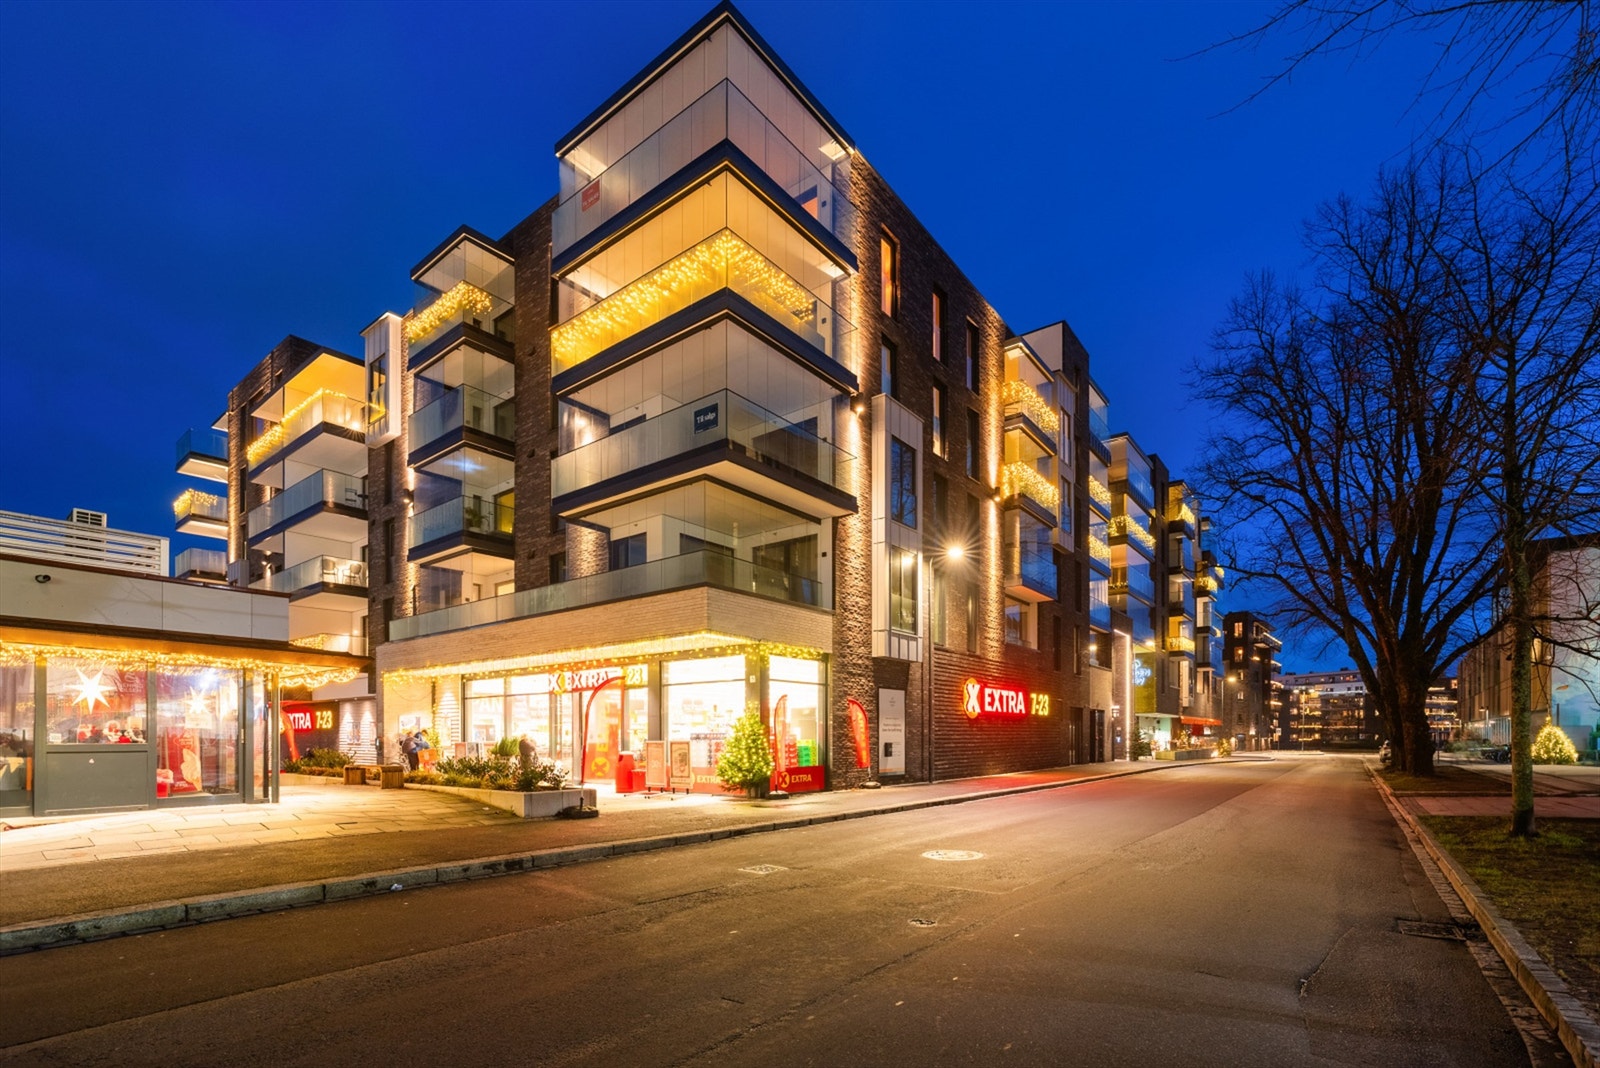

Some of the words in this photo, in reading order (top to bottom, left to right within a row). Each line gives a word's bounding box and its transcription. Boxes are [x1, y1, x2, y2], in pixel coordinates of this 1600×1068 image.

[565, 669, 609, 690] EXTRA
[984, 687, 1026, 714] EXTRA
[1030, 693, 1049, 716] 7-23
[287, 712, 312, 730] XTRA
[315, 710, 333, 729] 7-23
[791, 774, 812, 784] EXTRA
